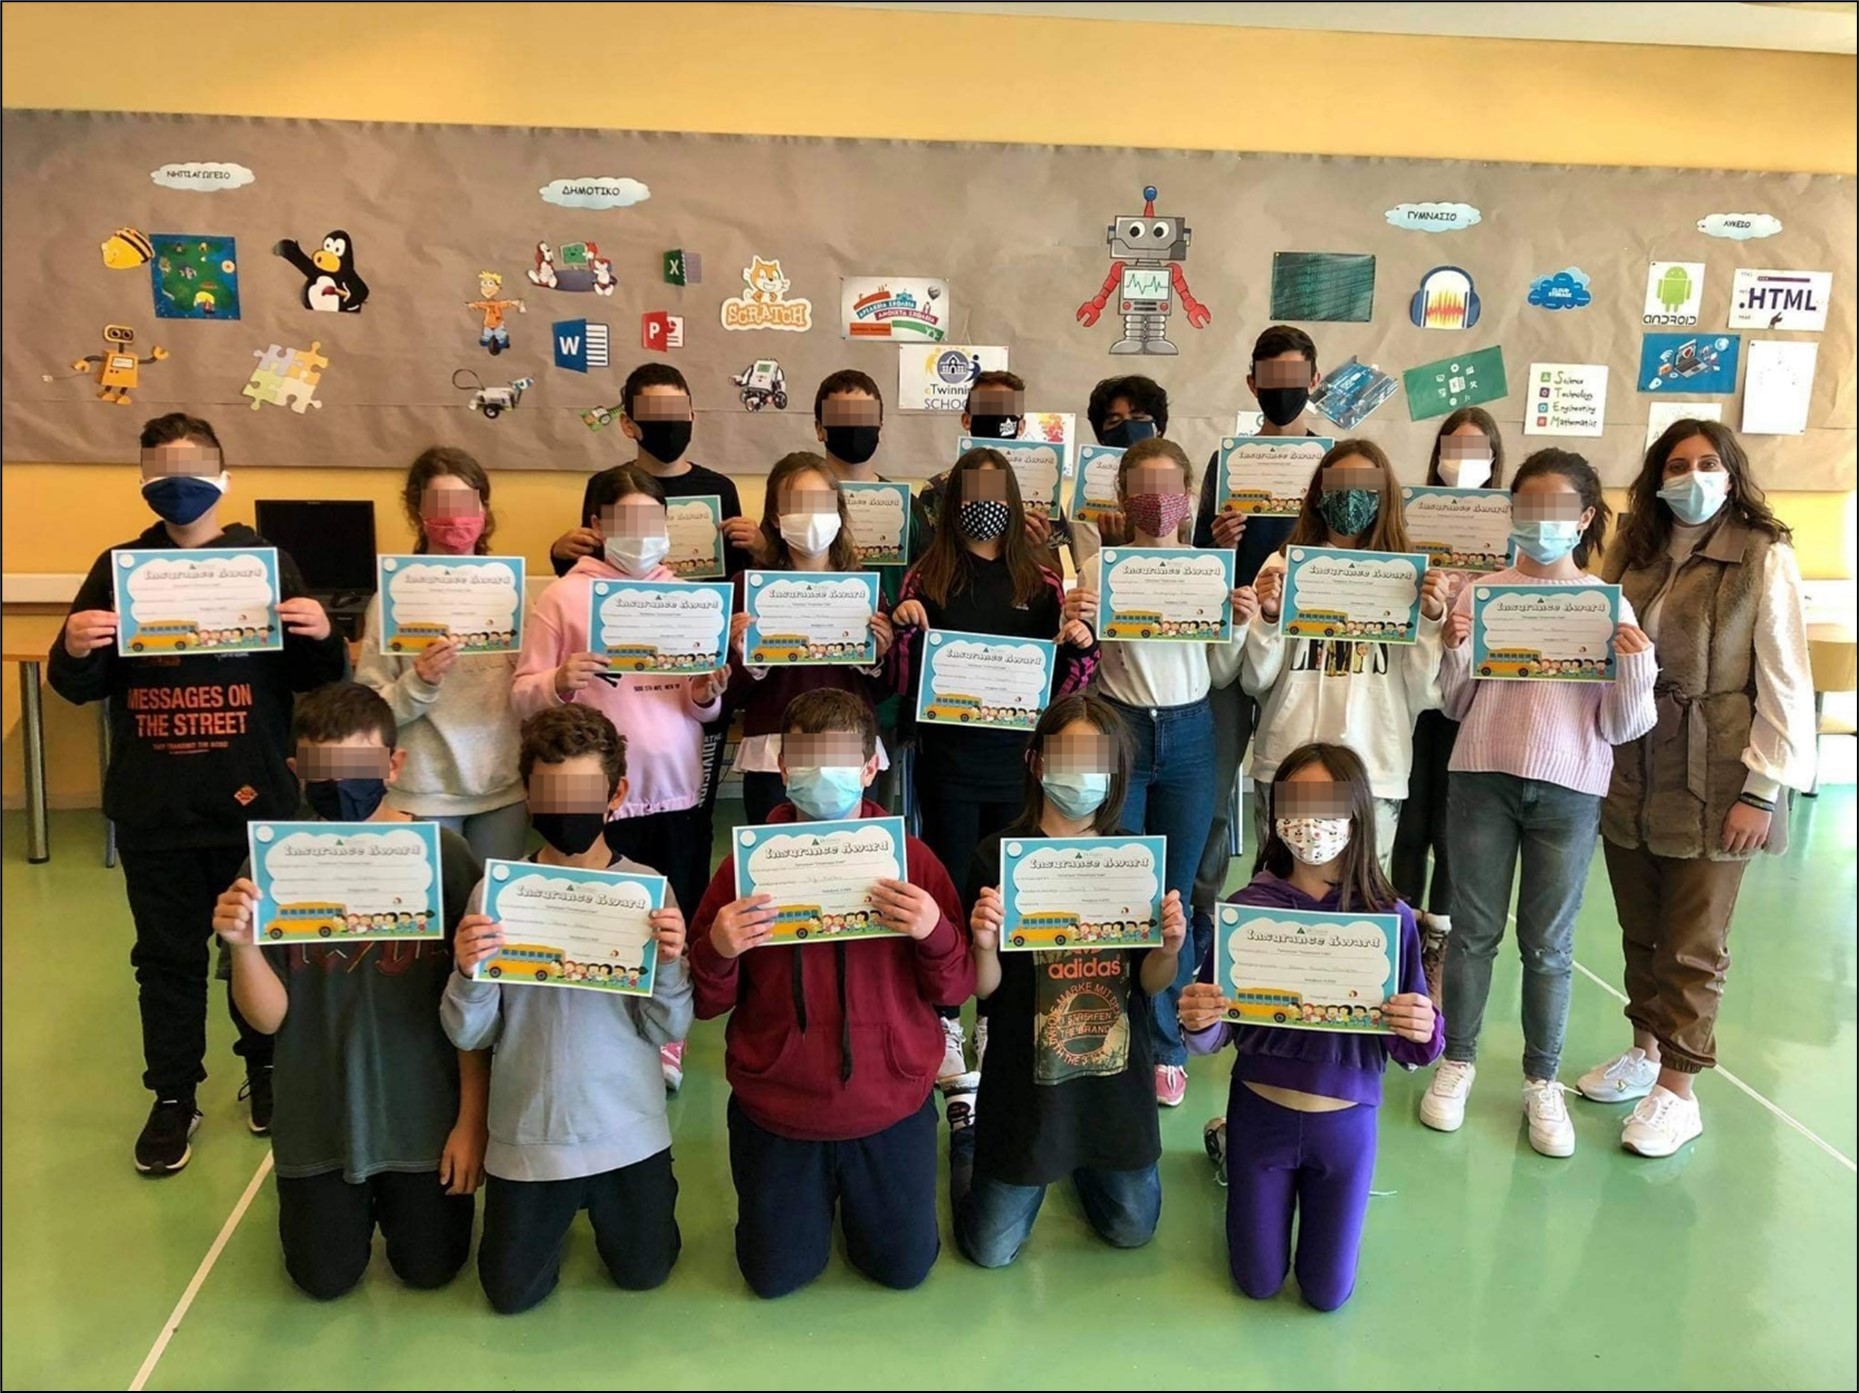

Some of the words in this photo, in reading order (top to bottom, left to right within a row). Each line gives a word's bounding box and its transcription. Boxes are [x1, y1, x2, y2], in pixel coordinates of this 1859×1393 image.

[166, 169, 231, 180] ΝΗΠΙΑΓΩΓΕΙΟ
[561, 185, 621, 196] ΔΗΜΟΤΙΚΟ
[1407, 210, 1457, 222] ΓΥΜΝΑΣΙΟ
[1723, 219, 1752, 229] ΛΥΚΕΙΟ
[669, 259, 680, 276] X
[725, 303, 808, 327] SCRATCH
[648, 321, 661, 340] P
[559, 335, 581, 356] W
[127, 685, 223, 710] MESSAGES
[227, 683, 253, 708] ON
[135, 713, 170, 738] THE
[173, 711, 248, 736] STREET
[284, 844, 365, 858] Insurance
[369, 844, 422, 857] Award
[765, 846, 838, 861] Insurance
[841, 840, 889, 854] Award
[1030, 858, 1101, 870] Insurance
[1103, 857, 1150, 869] Award
[517, 885, 594, 905] Insurance
[595, 894, 647, 910] Award
[1246, 928, 1325, 947] Insurance
[1328, 935, 1381, 949] Award
[1047, 957, 1121, 979] adidas
